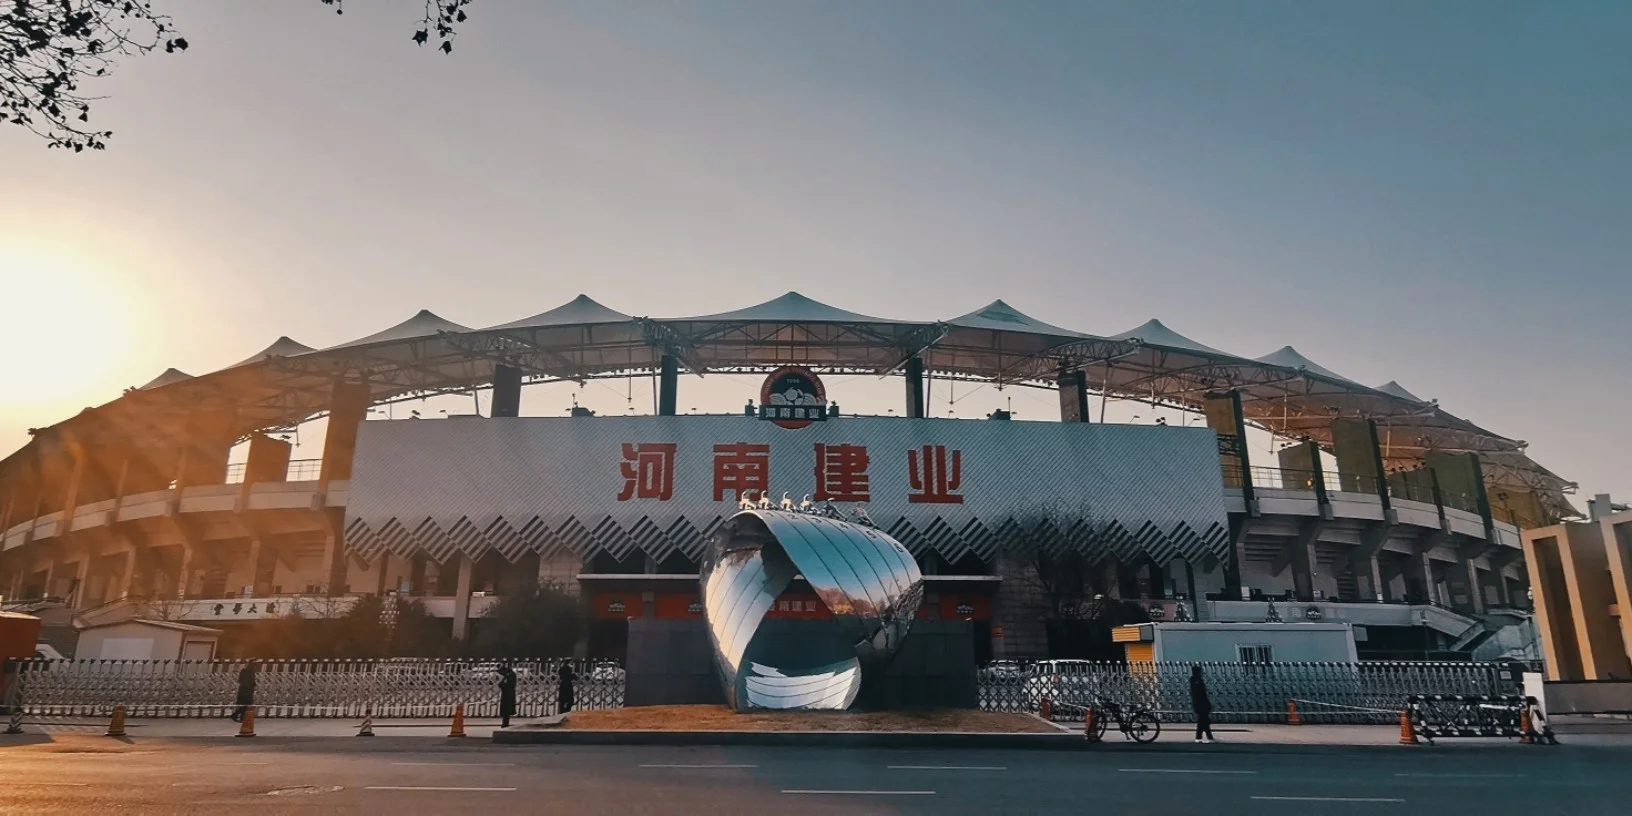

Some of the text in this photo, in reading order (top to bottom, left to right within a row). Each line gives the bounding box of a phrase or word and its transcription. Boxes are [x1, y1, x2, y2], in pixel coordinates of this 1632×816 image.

[765, 407, 820, 419] 河南建业
[617, 442, 965, 504] 河南建业
